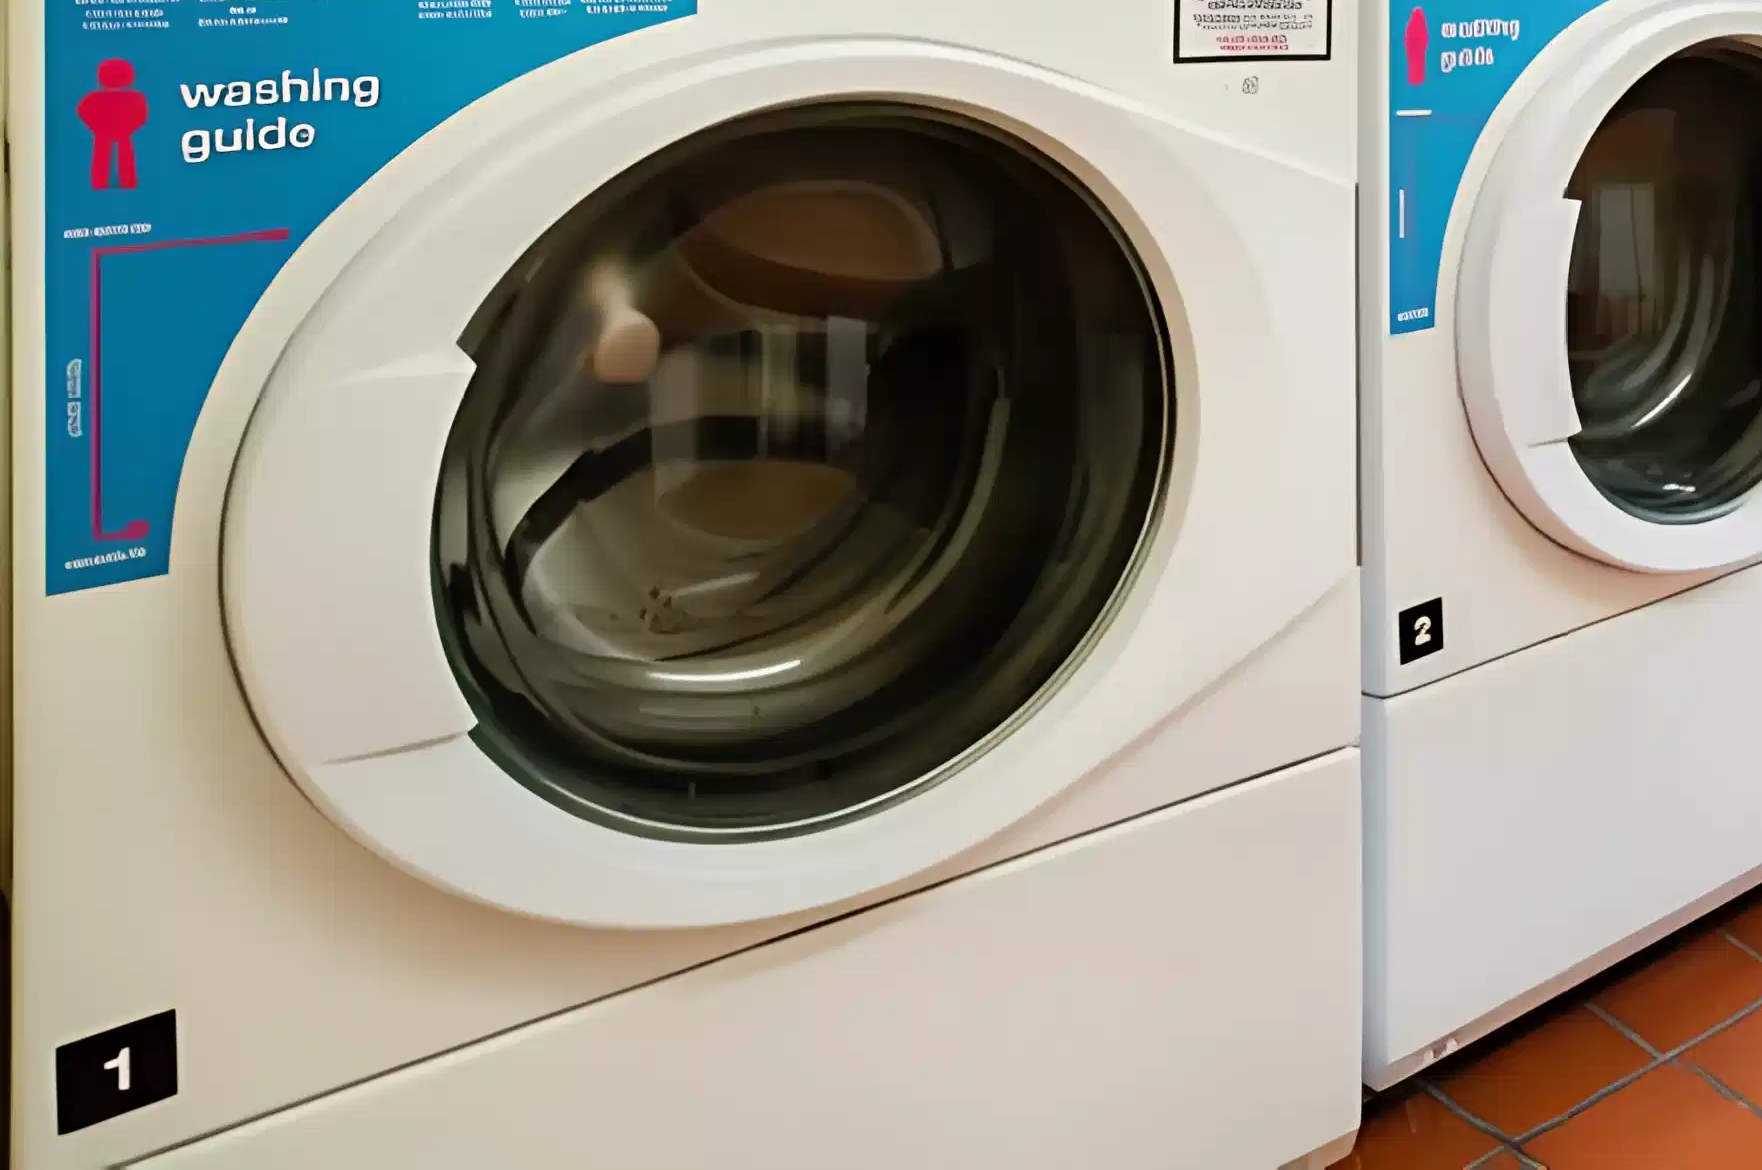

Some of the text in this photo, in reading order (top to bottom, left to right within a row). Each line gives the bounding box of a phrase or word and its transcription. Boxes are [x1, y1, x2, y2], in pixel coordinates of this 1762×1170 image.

[179, 67, 380, 109] washing
[1413, 615, 1432, 646] 2
[103, 1046, 131, 1091] 1
